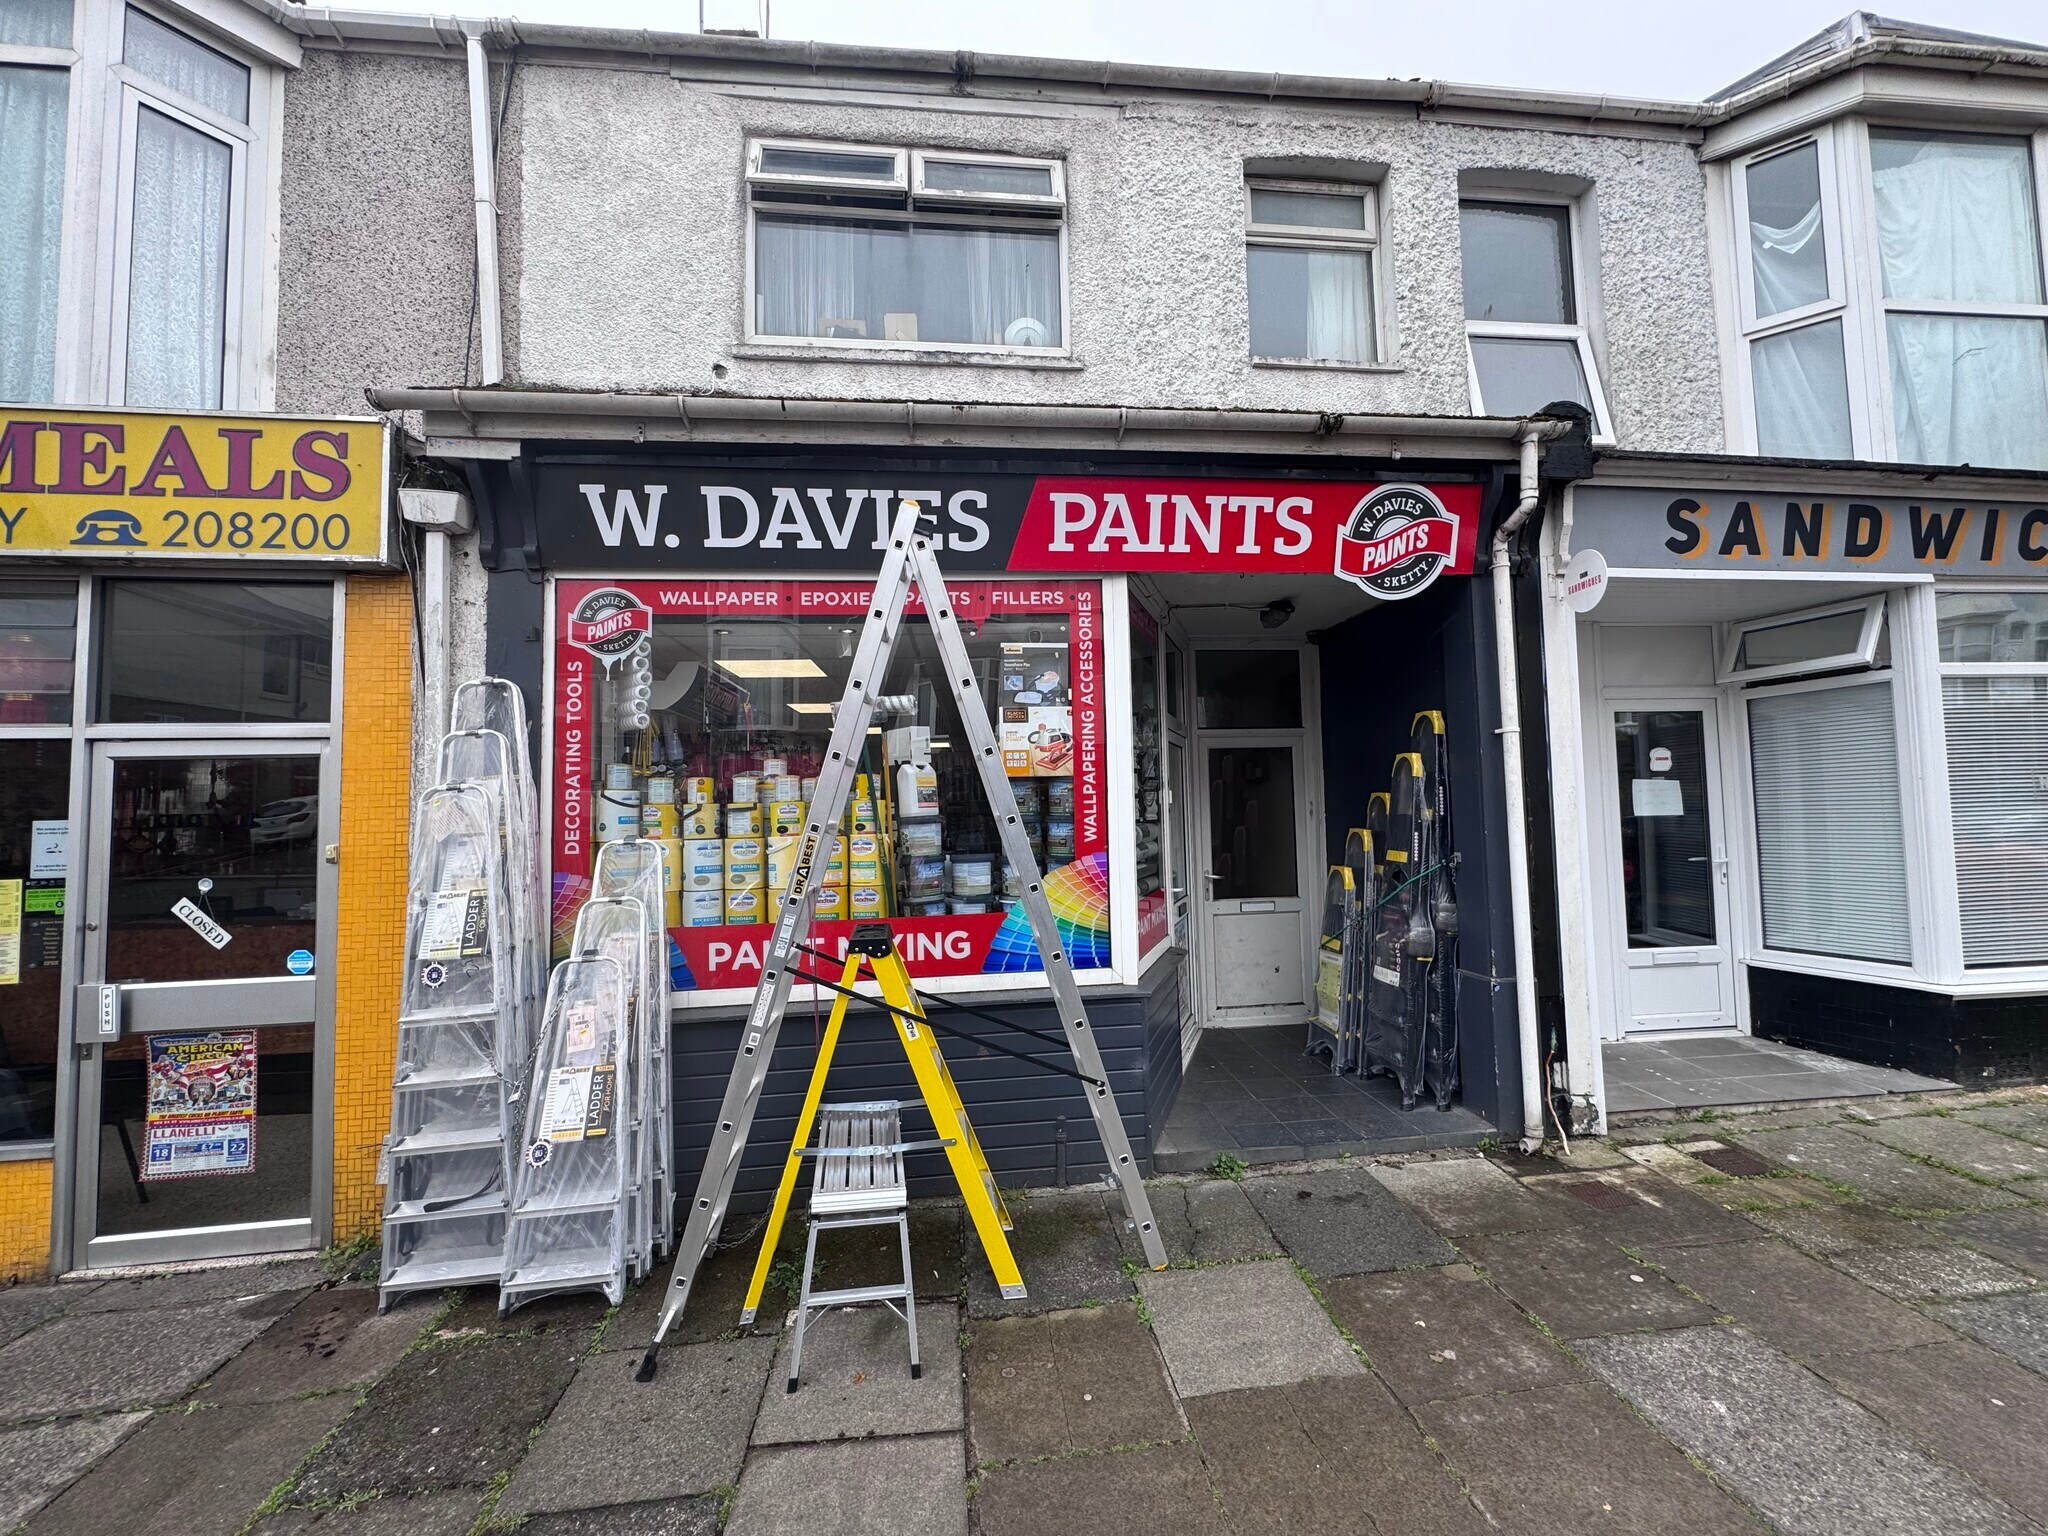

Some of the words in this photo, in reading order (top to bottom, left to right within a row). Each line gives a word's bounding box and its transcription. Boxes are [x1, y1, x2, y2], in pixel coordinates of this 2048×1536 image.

[162, 509, 351, 551] 208200
[579, 484, 680, 549] W.
[700, 486, 990, 552] DAVIES
[1048, 492, 1313, 556] PAINTS
[1360, 517, 1376, 533] W.
[1372, 498, 1424, 519] DAVIES
[1362, 523, 1429, 572] PAINTS
[1384, 560, 1429, 587] SKETTY
[584, 608, 595, 619] W.
[593, 596, 627, 610] DAVIES
[659, 590, 778, 606] WALLPAPER
[801, 591, 875, 606] EPOXIE
[904, 591, 971, 606] PTS
[991, 591, 1064, 605] FILLERS
[587, 612, 633, 641] PAINTS
[603, 634, 634, 651] SKETTY
[1078, 591, 1094, 706] ACCESSORIES
[566, 660, 583, 724] TOOLS
[1080, 709, 1097, 843] WALLPAPERING
[564, 729, 582, 855] DECORATING
[178, 904, 224, 945] CLOSED
[463, 898, 480, 949] LADDER
[708, 936, 825, 971] PAIT
[837, 930, 971, 964] MING
[167, 1043, 243, 1054] AMERICAN
[604, 1073, 614, 1095] HOME
[587, 1074, 605, 1128] LADDER
[602, 1095, 612, 1112] FOR
[153, 1126, 216, 1139] LLANELLI
[153, 1148, 169, 1158] 18
[229, 1143, 246, 1152] 22
